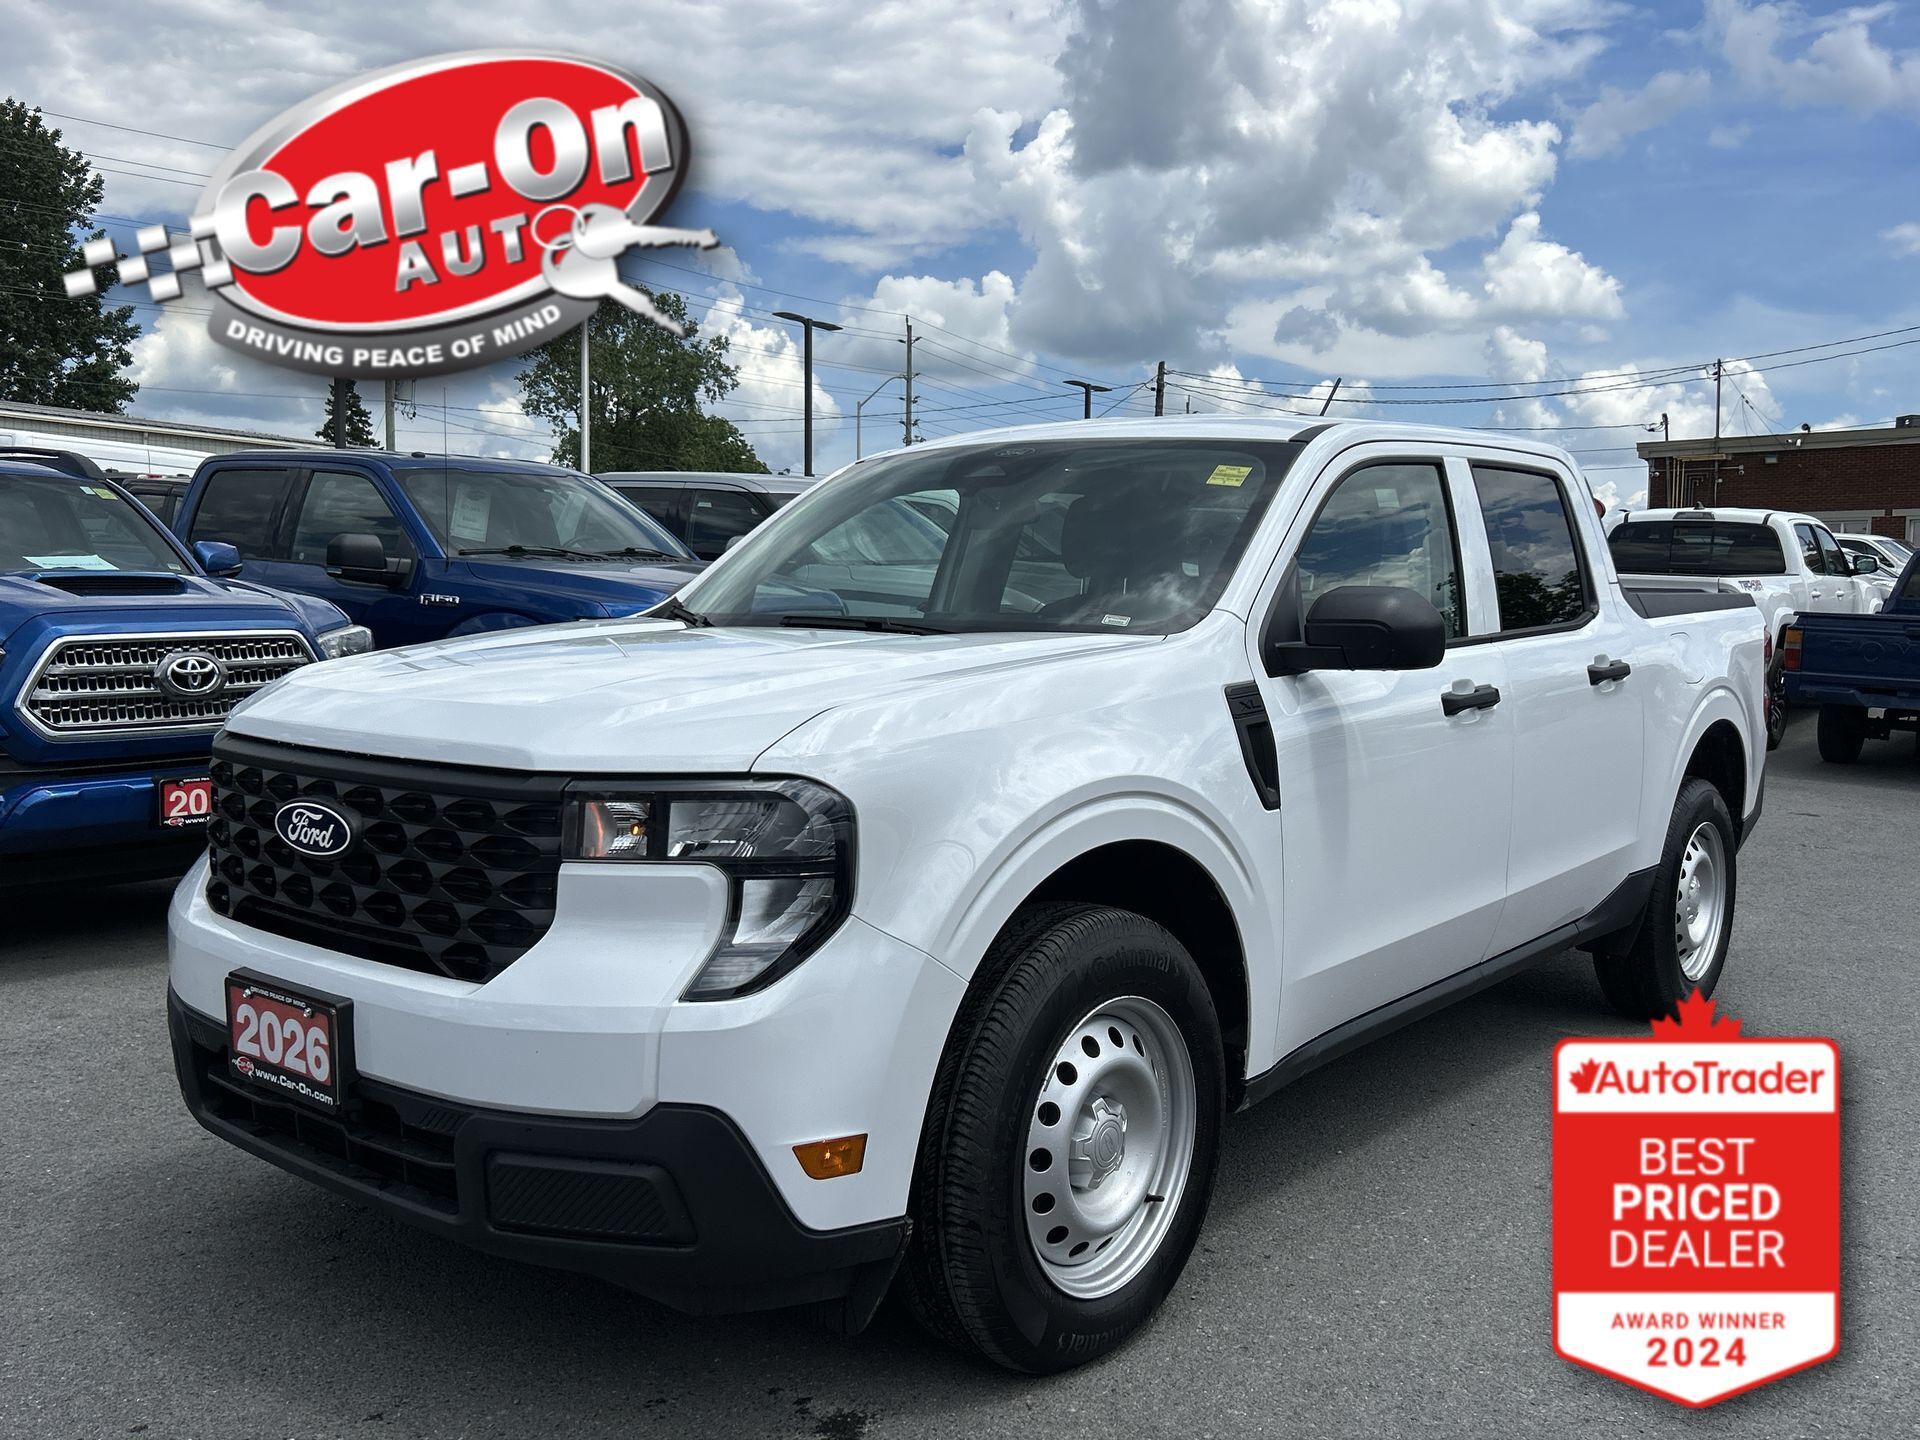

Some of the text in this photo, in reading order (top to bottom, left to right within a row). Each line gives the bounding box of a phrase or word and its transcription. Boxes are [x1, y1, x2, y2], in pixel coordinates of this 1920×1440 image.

[169, 788, 208, 817] 20
[287, 808, 335, 848] Ford
[236, 1003, 330, 1082] 2026
[255, 1068, 334, 1106] www.Car-On.com
